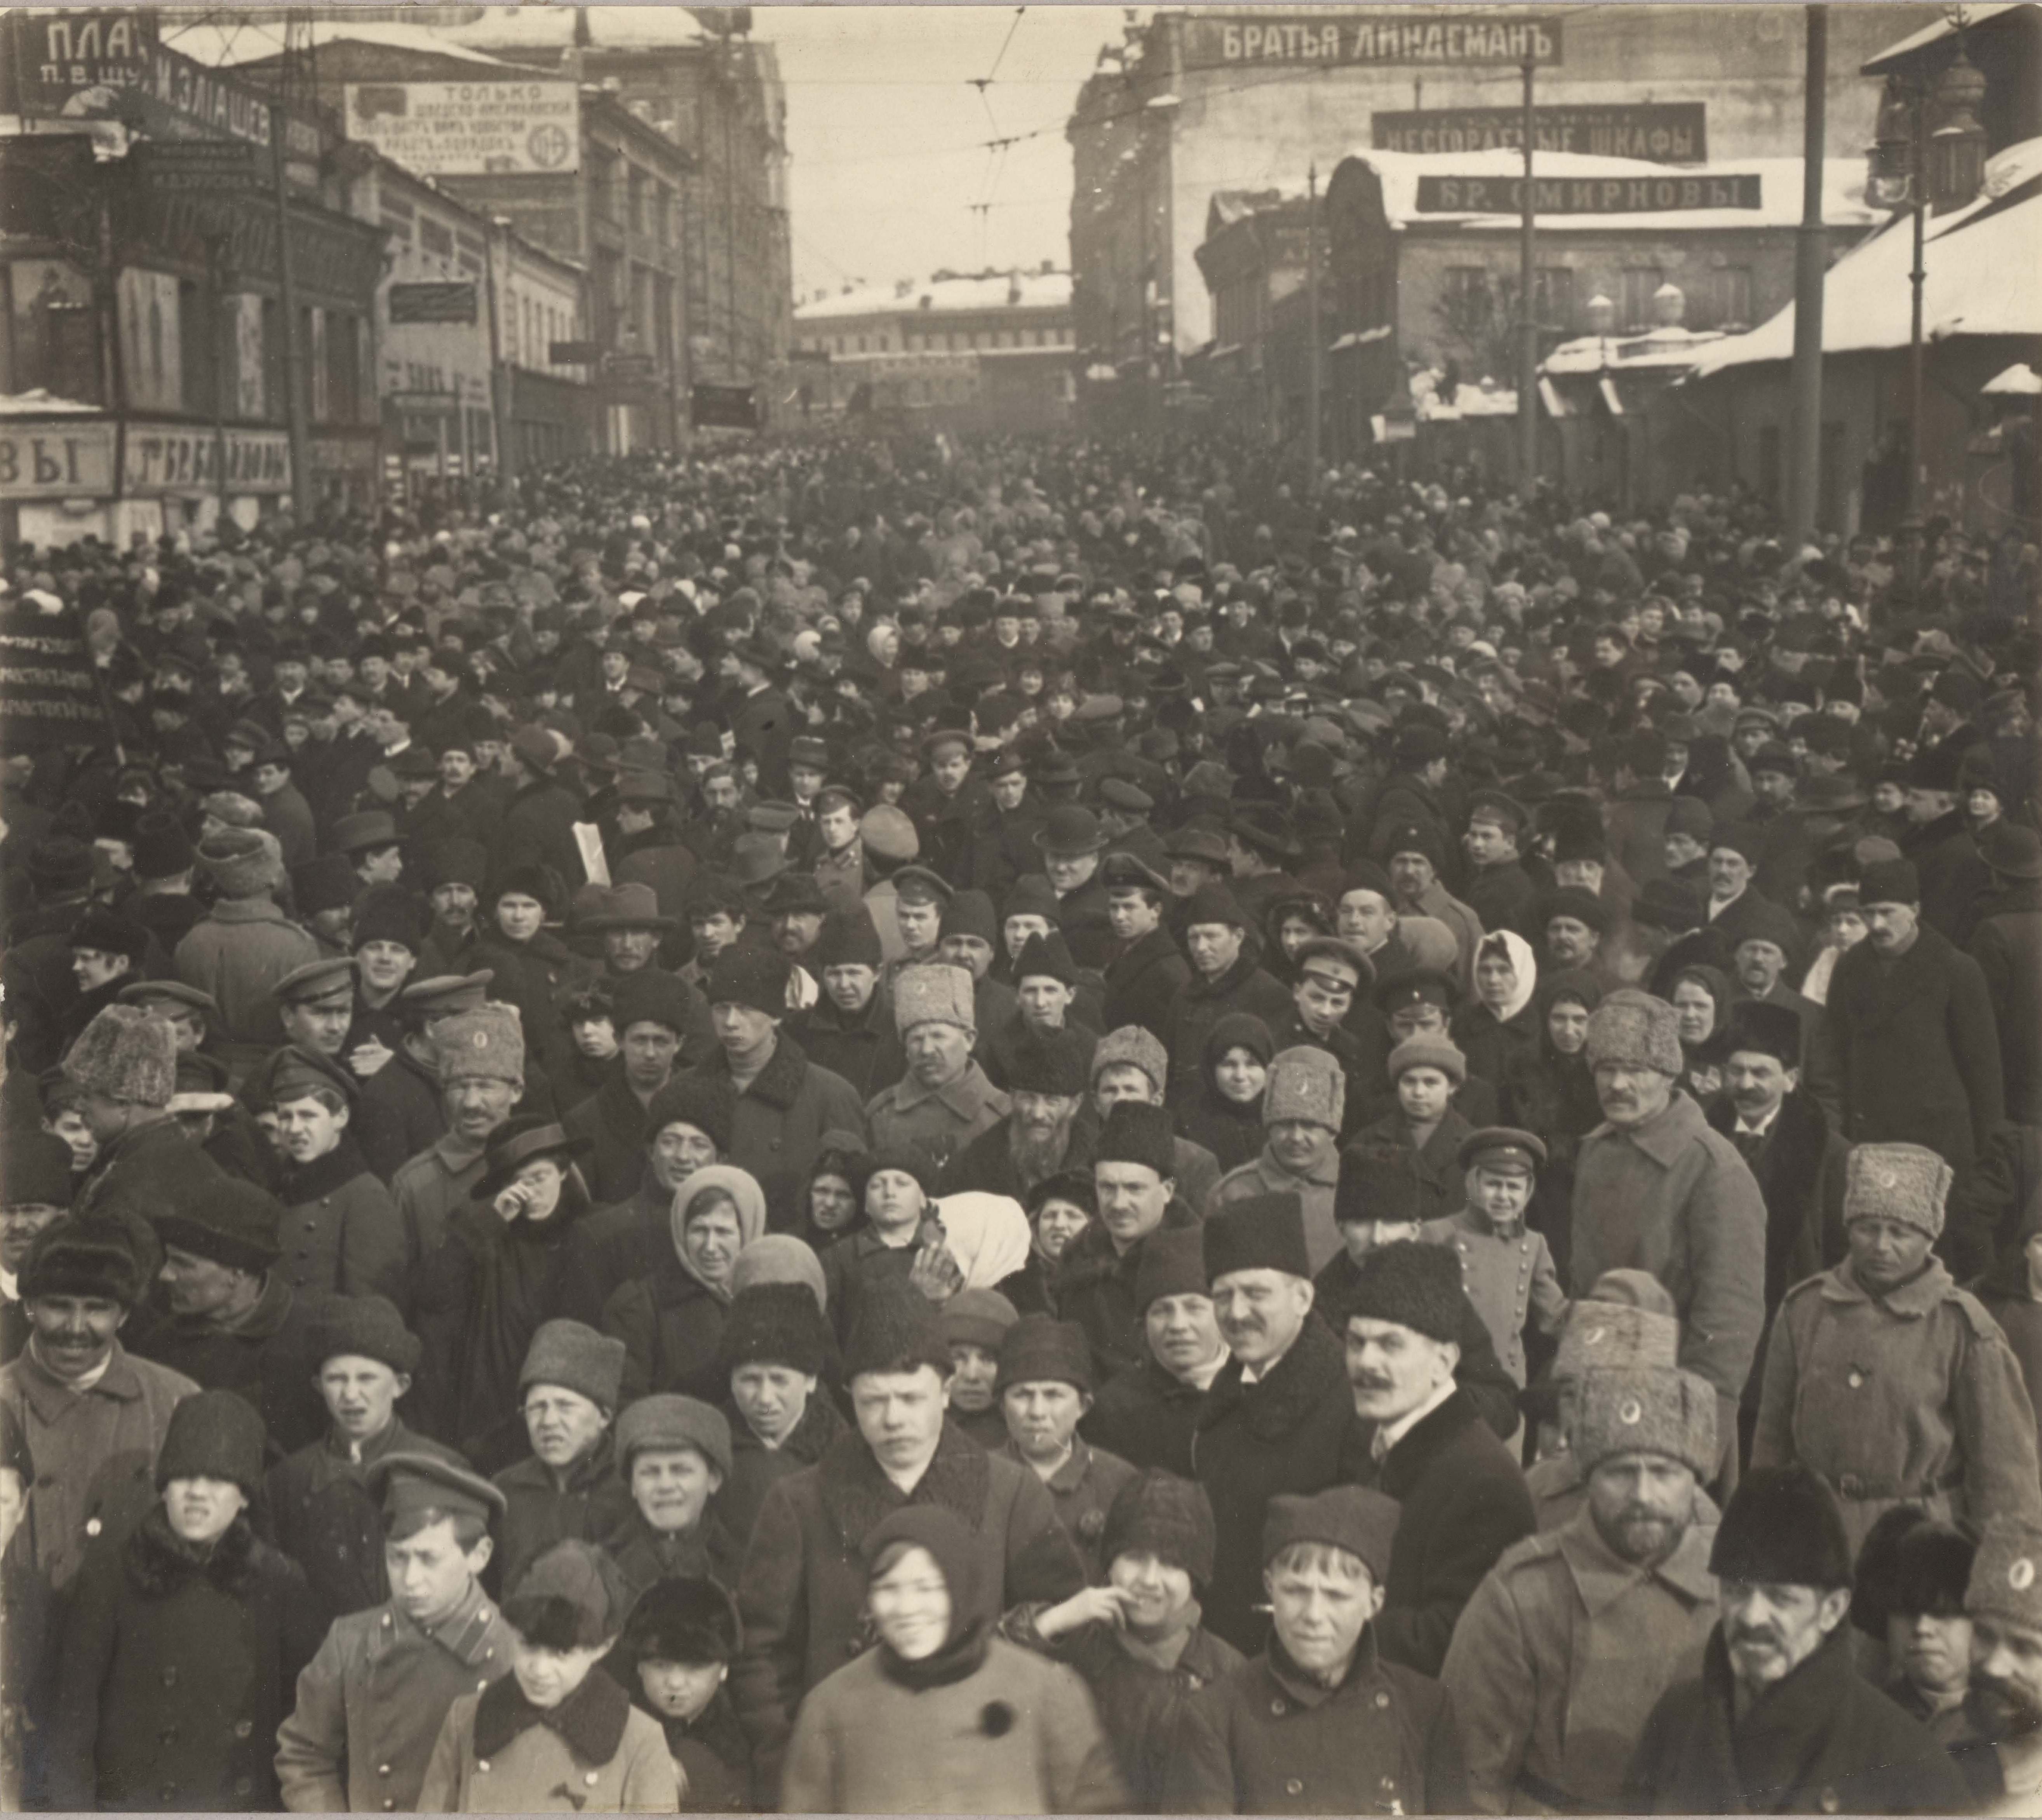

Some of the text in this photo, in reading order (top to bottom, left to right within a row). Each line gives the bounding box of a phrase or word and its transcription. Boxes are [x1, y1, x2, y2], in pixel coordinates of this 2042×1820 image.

[47, 16, 134, 61] ПЛА
[1223, 23, 1553, 59] БРАТЬЯ ЛИНДЕМАНЪ
[444, 85, 542, 101] ТОЛЬКО
[1589, 127, 1693, 156] ШКАФЫ
[1439, 180, 1741, 208] БР. СМИРНОВЫ
